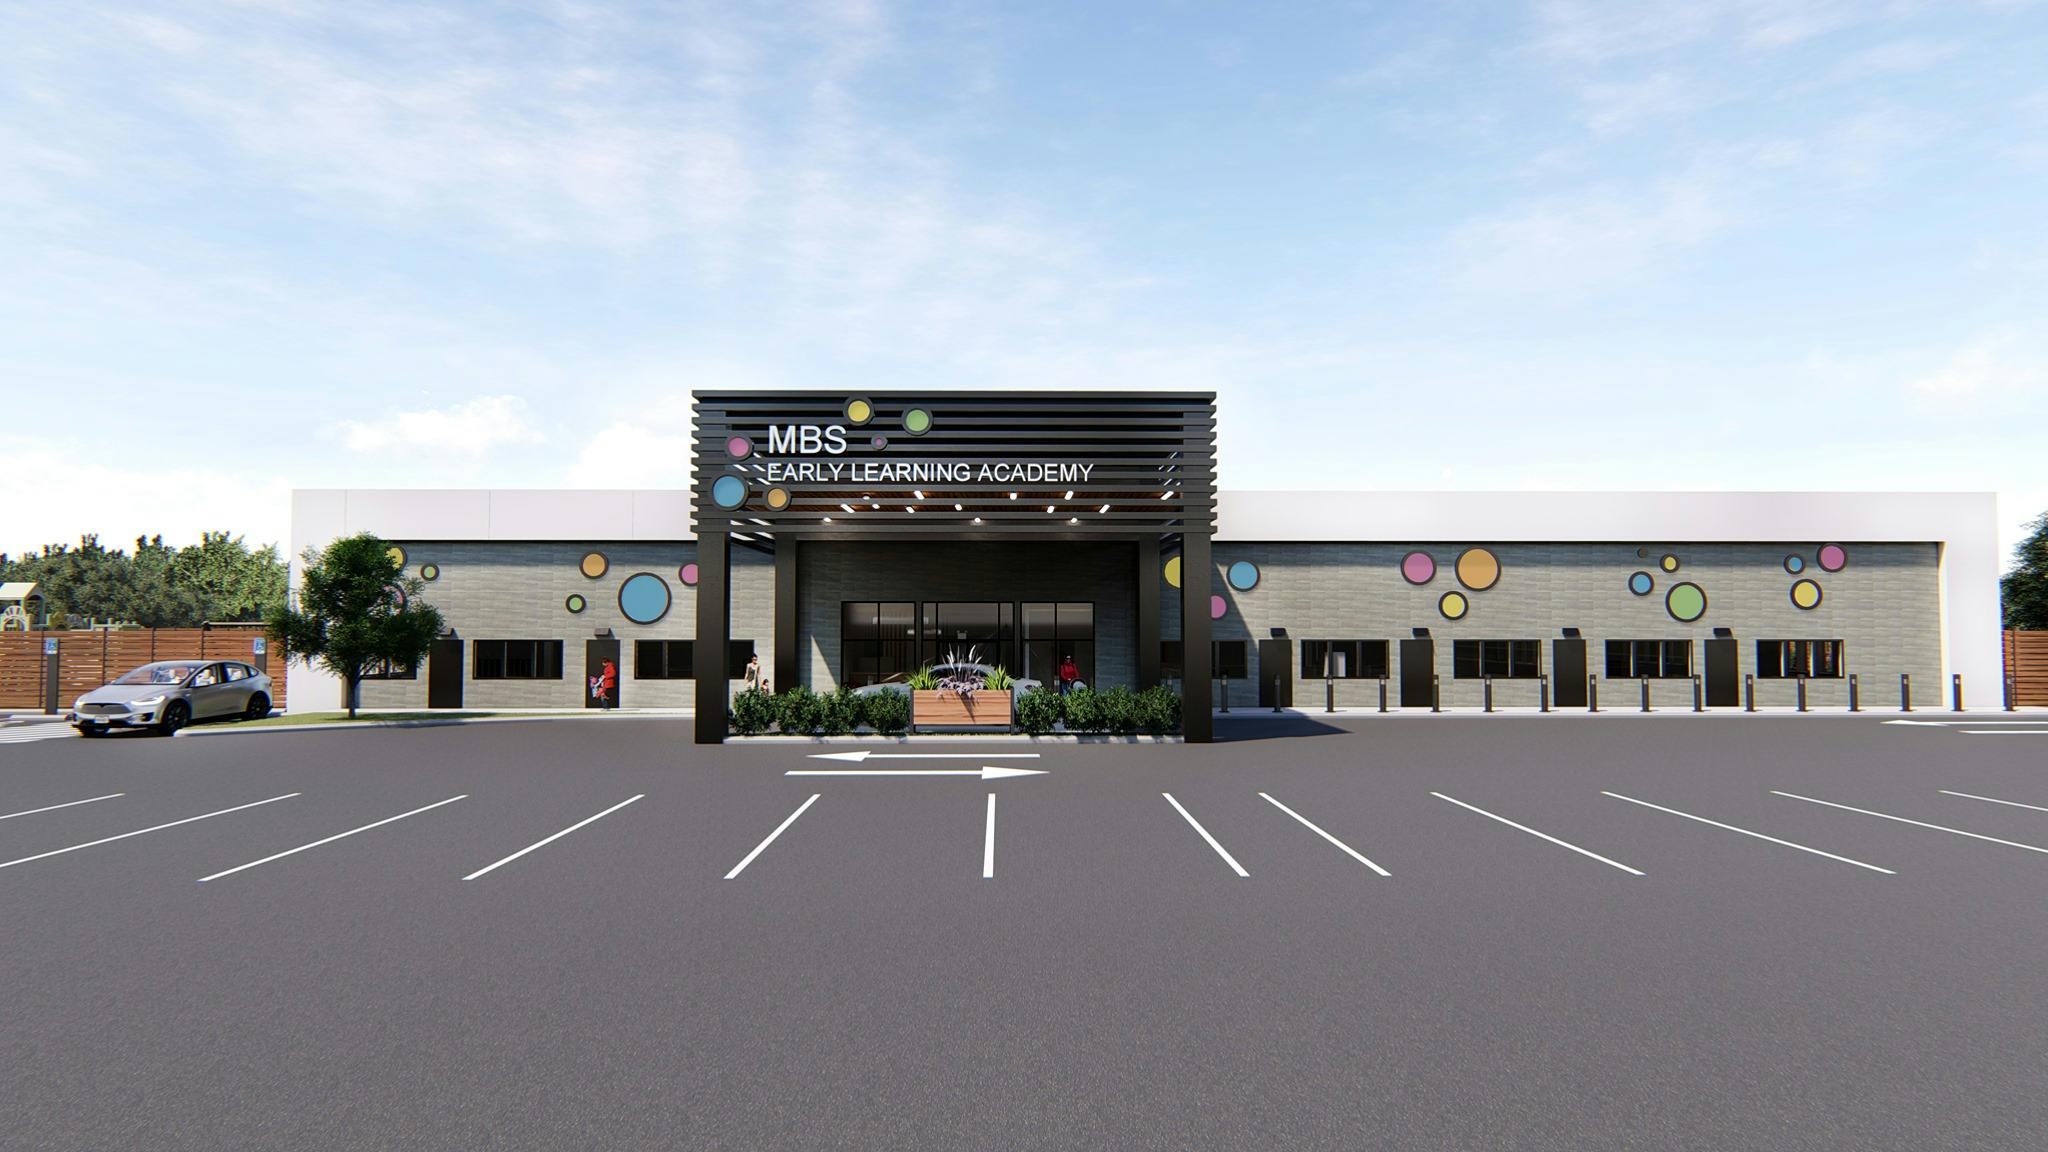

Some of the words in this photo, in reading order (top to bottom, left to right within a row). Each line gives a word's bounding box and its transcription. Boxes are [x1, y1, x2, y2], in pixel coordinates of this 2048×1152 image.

[768, 425, 847, 454] MBS
[767, 462, 844, 482] EARLY
[851, 462, 971, 482] LEARNING
[977, 462, 1094, 482] ACADEMY
